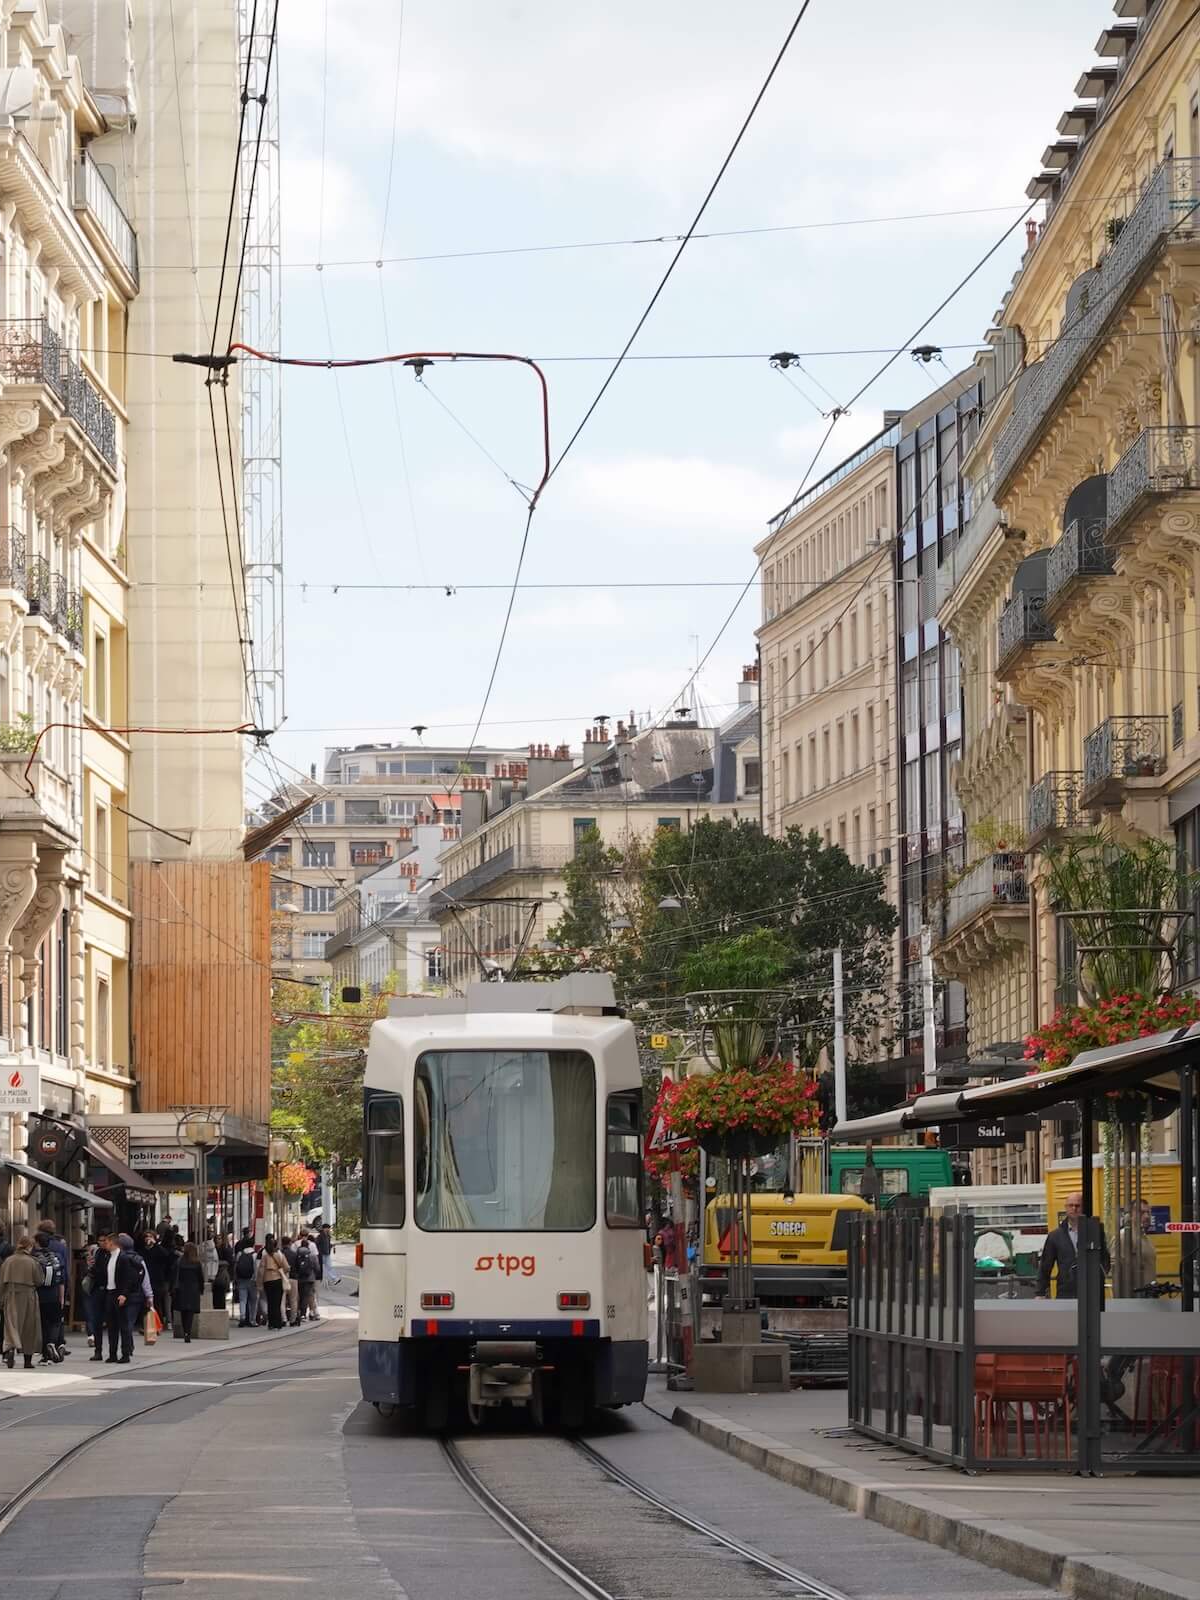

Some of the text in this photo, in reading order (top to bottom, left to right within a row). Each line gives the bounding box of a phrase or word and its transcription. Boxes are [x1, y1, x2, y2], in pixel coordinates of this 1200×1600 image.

[978, 1126, 1006, 1137] Salt.
[42, 1140, 57, 1149] ice
[770, 1222, 806, 1236] SOGECA
